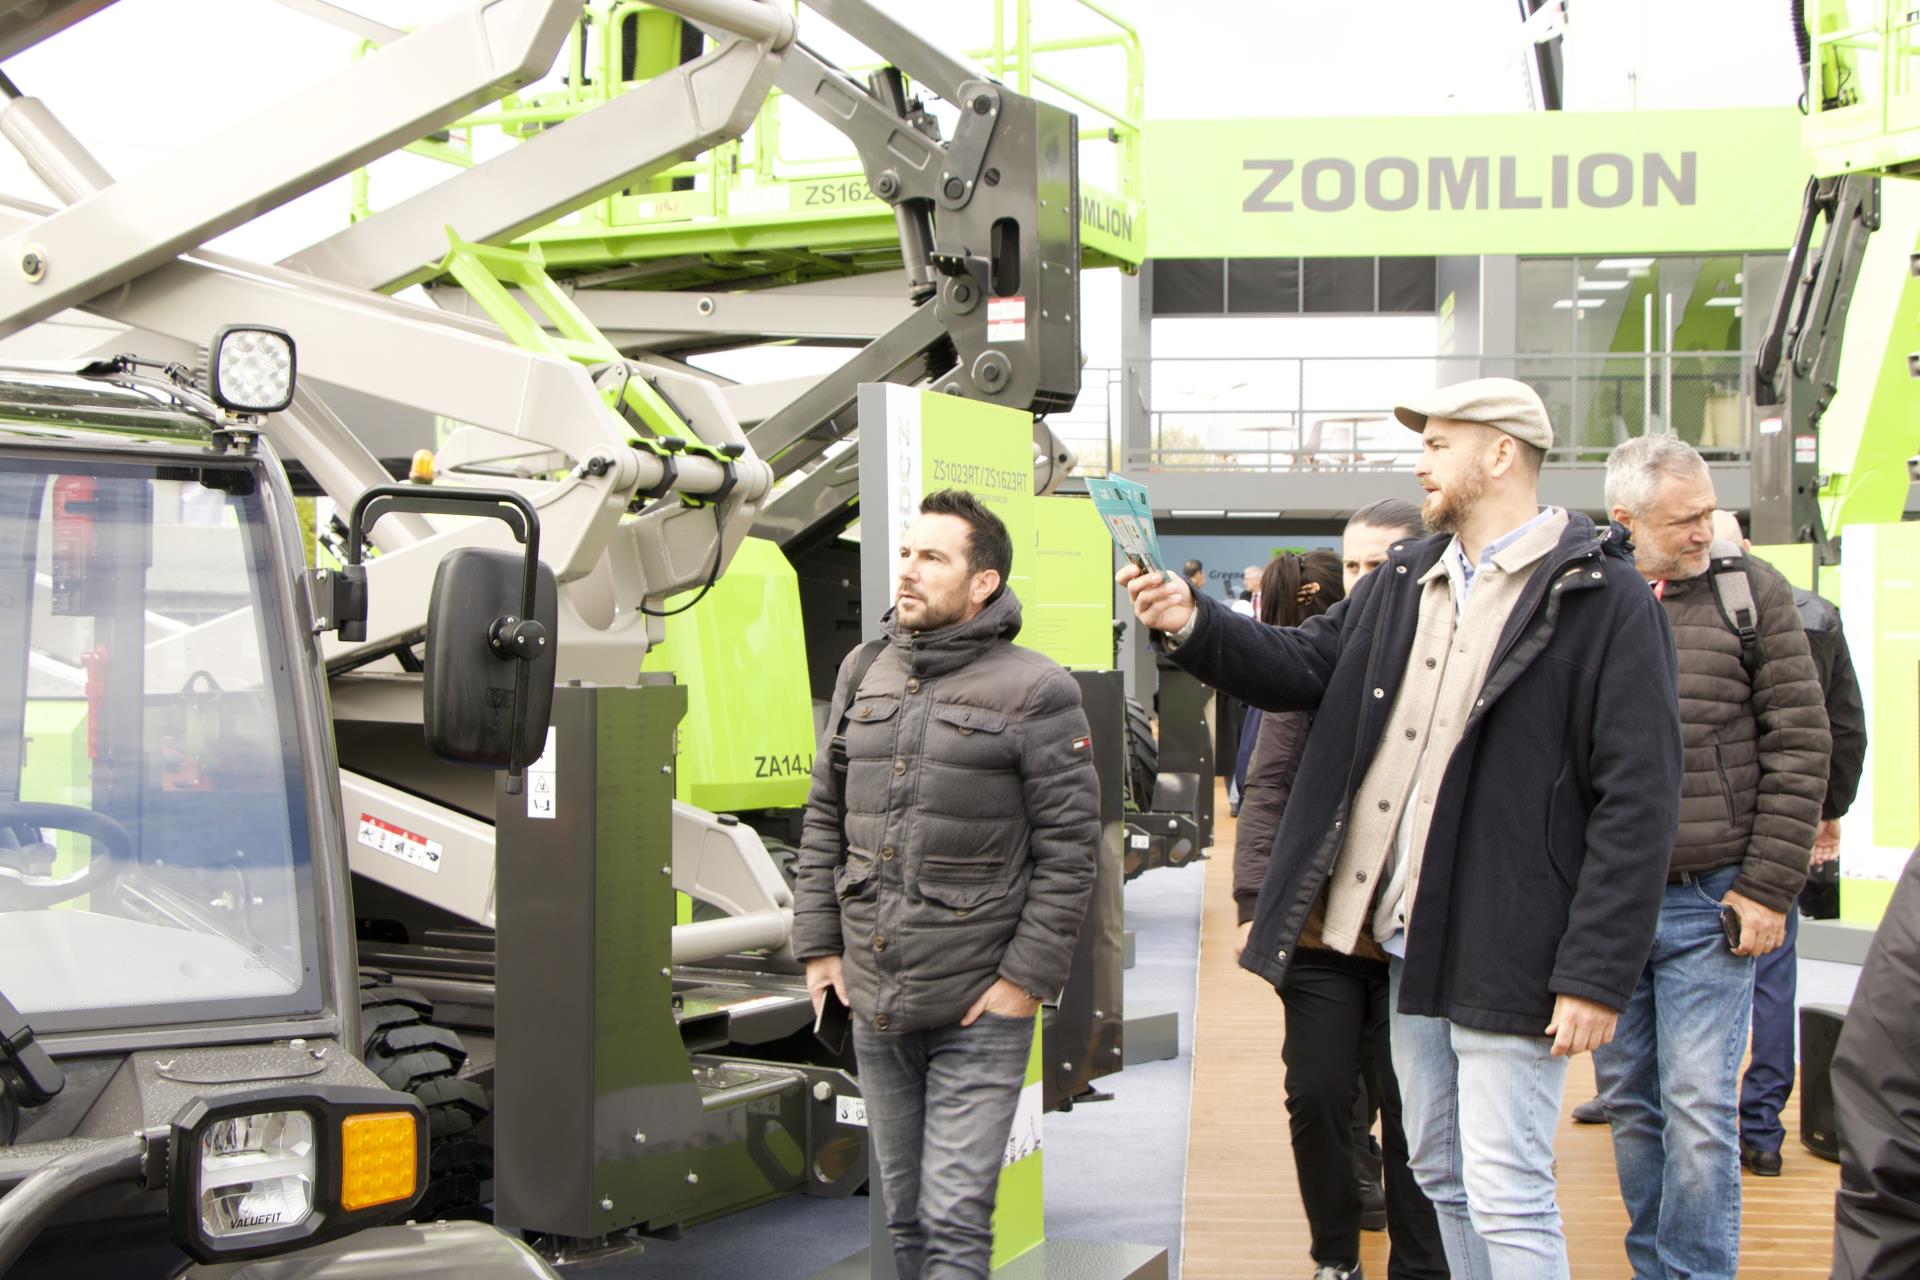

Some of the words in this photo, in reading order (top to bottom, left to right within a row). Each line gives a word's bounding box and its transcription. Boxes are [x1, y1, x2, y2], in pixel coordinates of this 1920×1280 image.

[1242, 151, 1697, 212] ZOOMLION
[933, 459, 1028, 492] ZS1023RT/ZS1623RT
[230, 1212, 282, 1229] VALUEFIT
